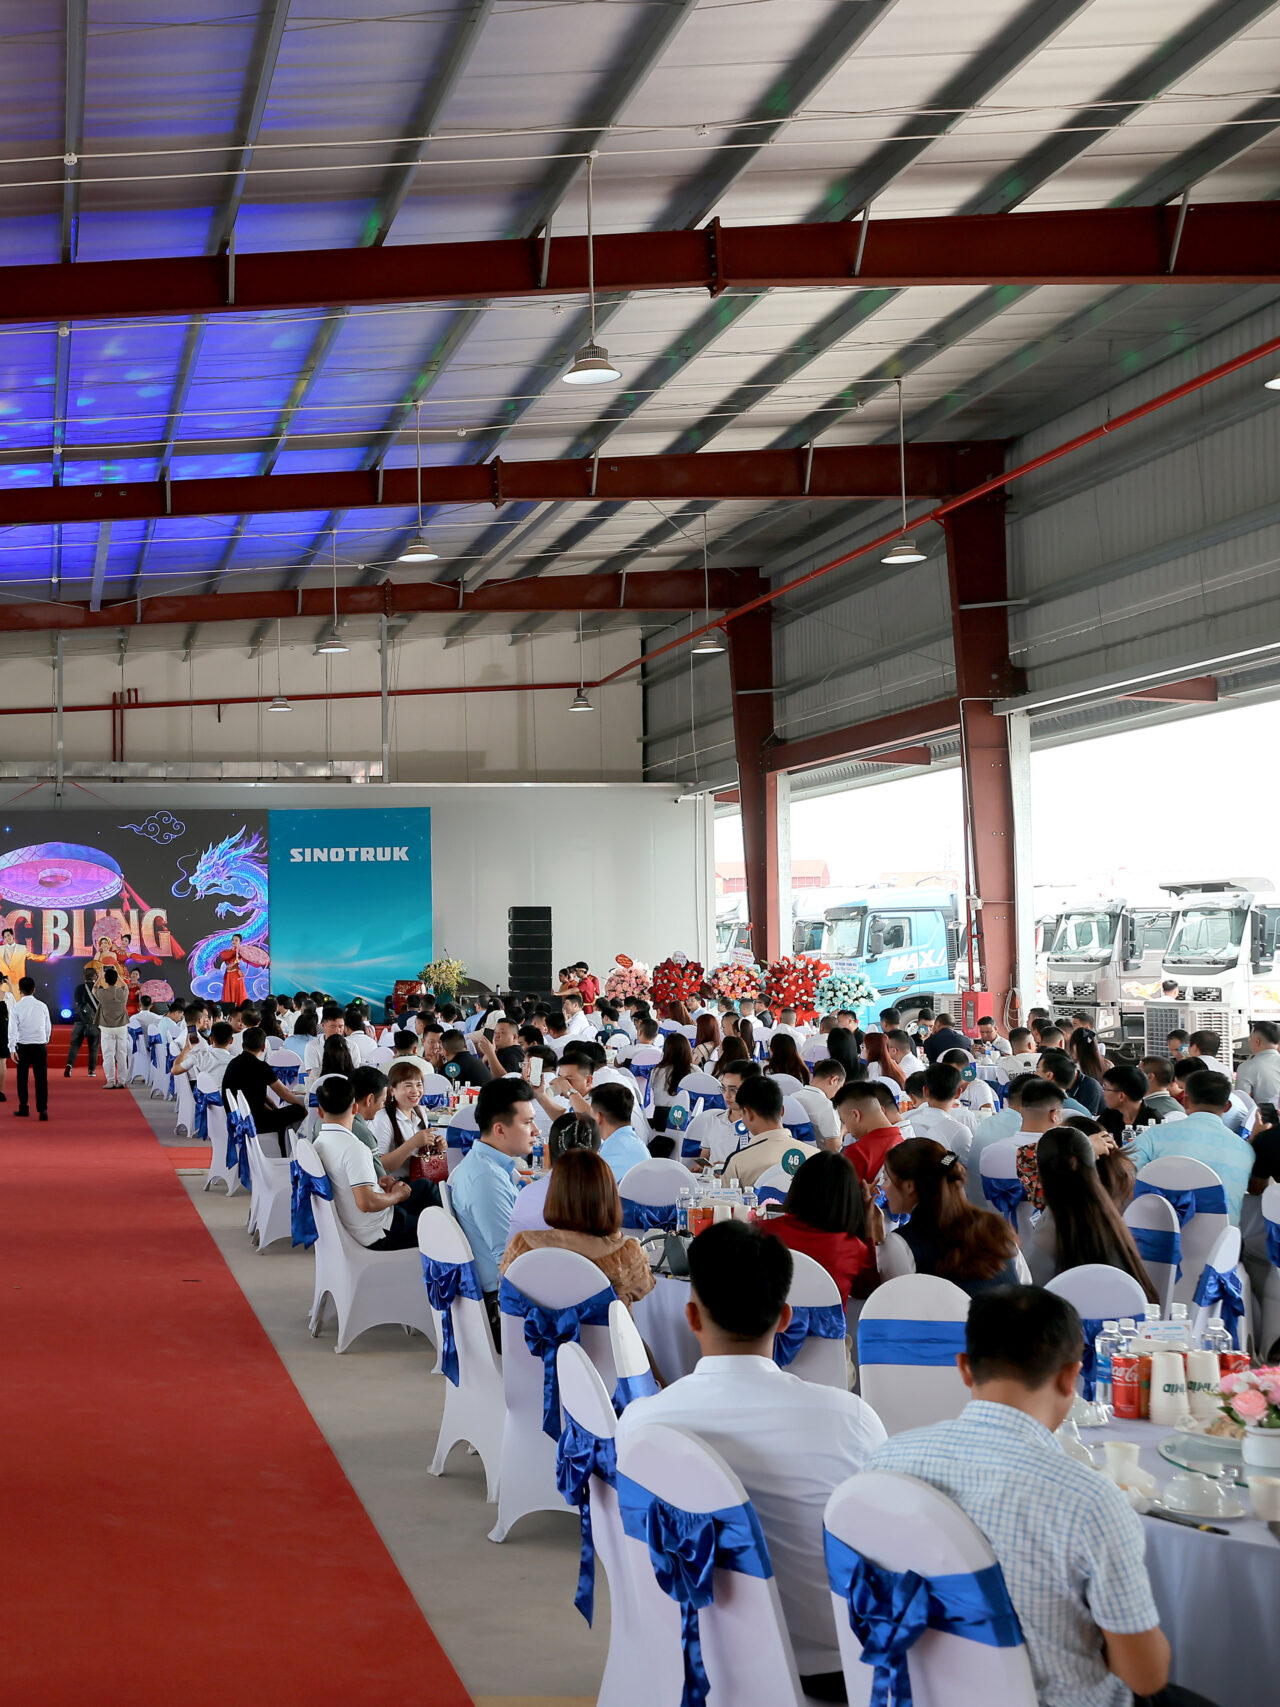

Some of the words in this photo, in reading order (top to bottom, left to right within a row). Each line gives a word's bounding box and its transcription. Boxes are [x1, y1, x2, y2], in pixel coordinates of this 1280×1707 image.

[290, 846, 409, 863] SINOTRUK
[673, 1109, 682, 1119] 40
[788, 1154, 800, 1166] 46
